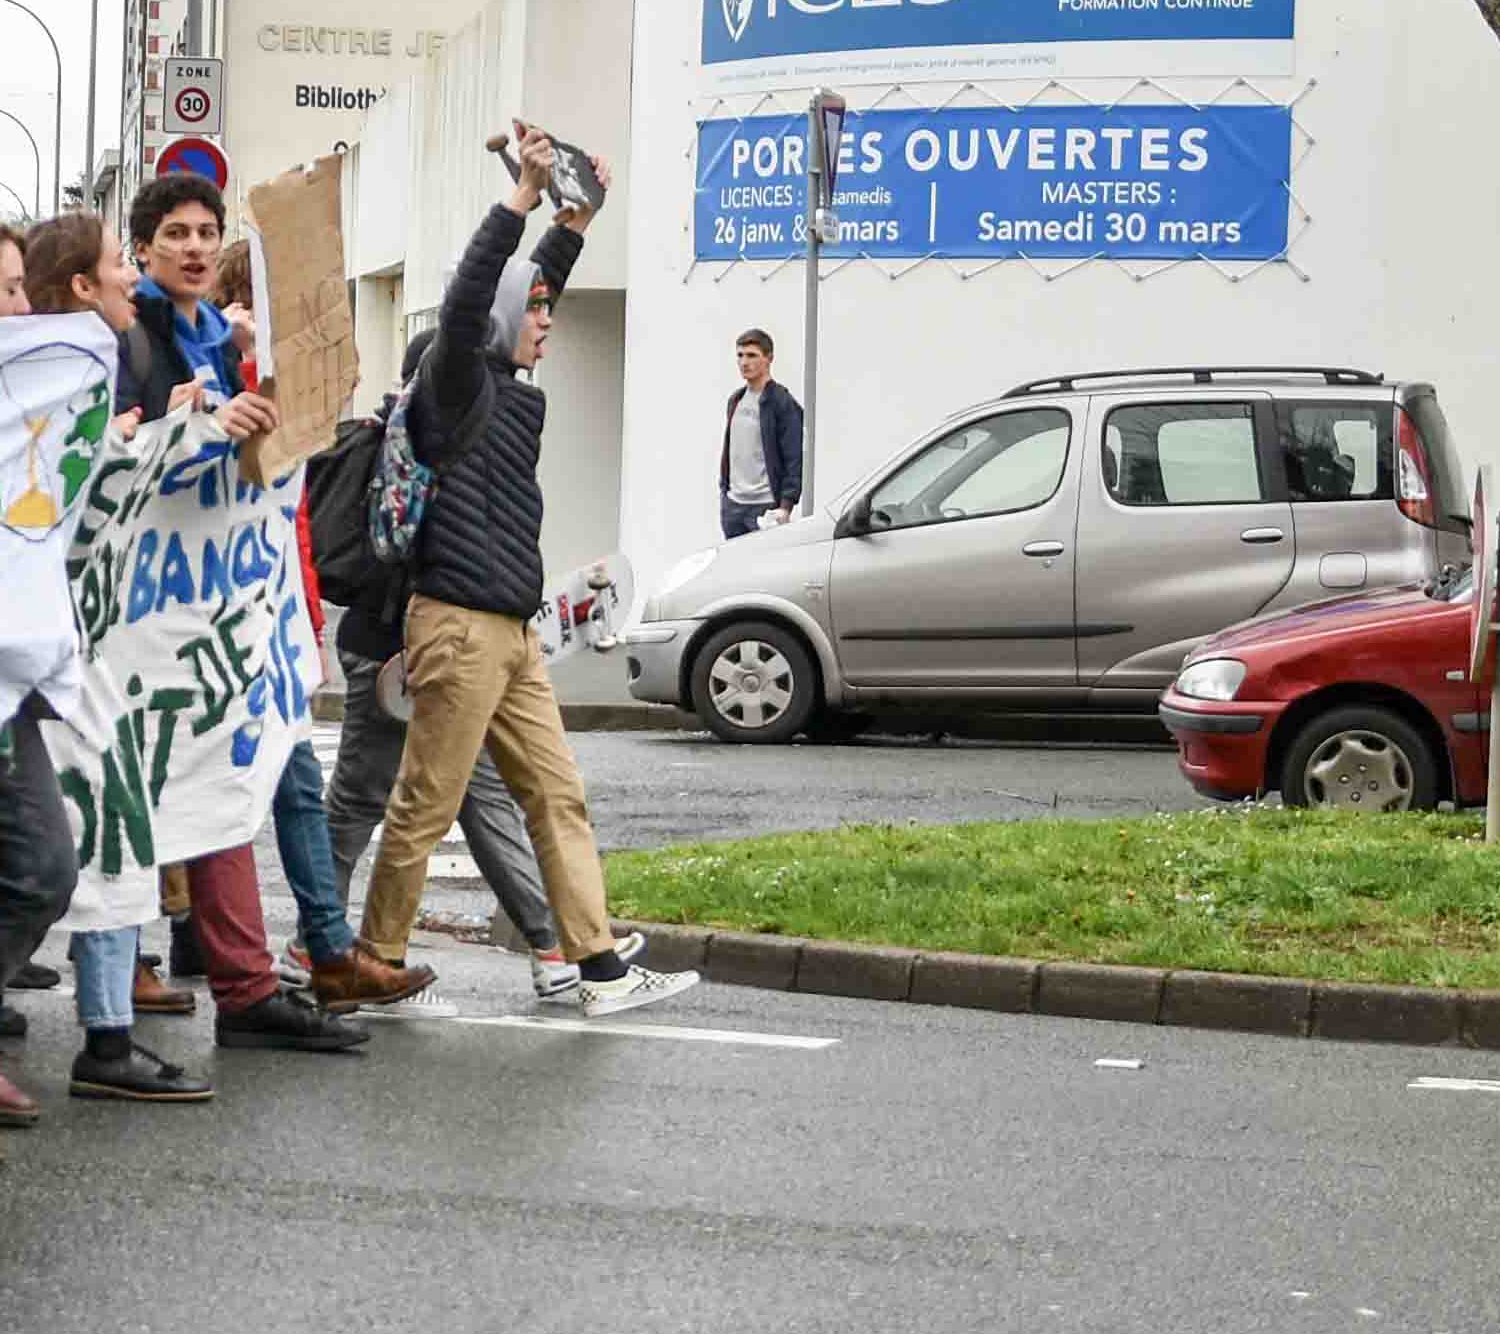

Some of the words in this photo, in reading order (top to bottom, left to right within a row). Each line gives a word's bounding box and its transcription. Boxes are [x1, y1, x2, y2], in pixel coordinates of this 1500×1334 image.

[256, 25, 393, 56] CENTRE
[175, 66, 212, 78] ZONE
[182, 97, 204, 113] 30
[295, 84, 387, 110] Biblioth
[732, 130, 883, 179] PORES
[904, 128, 1210, 172] OUVERTES
[720, 184, 793, 209] LICENCES
[1041, 181, 1162, 205] MASTERS
[714, 216, 736, 244] 26
[739, 216, 785, 252] janv.
[838, 219, 899, 242] mars
[977, 211, 1096, 243] Samedi
[1104, 213, 1147, 243] 30
[1158, 218, 1242, 244] mars
